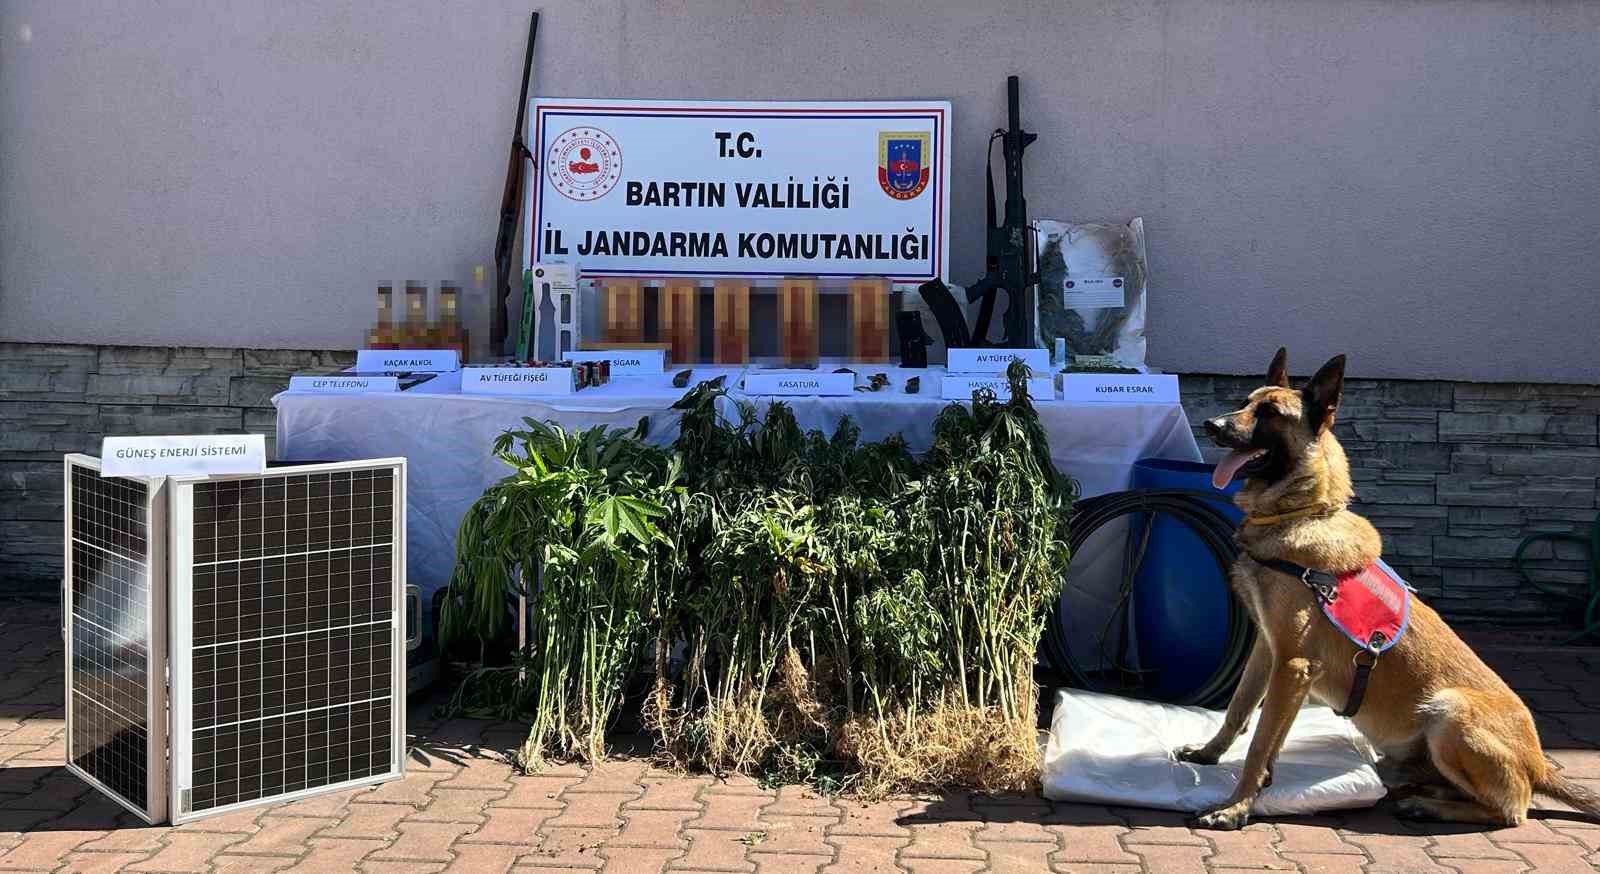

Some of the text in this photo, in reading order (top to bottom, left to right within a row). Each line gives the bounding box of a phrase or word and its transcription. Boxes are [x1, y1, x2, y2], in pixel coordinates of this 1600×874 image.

[714, 132, 763, 158] T.C.
[625, 175, 850, 209] BARTIN VALİLİĞİ
[543, 222, 930, 261] İL JANDARMA KOMUTANLIĞI
[383, 359, 433, 369] KAÇAK ALKOL
[612, 358, 641, 367] SİGARA
[976, 355, 989, 363] AV
[479, 373, 549, 384] AV TÜFEĞİ FİŞEĞİ
[312, 380, 369, 389] CEP TELEFONU
[778, 381, 820, 389] KASATURA
[1095, 385, 1154, 394] KUBAR ESRAR
[115, 443, 247, 459] GÜNEŞ ENERJİ SİSTEMİ
